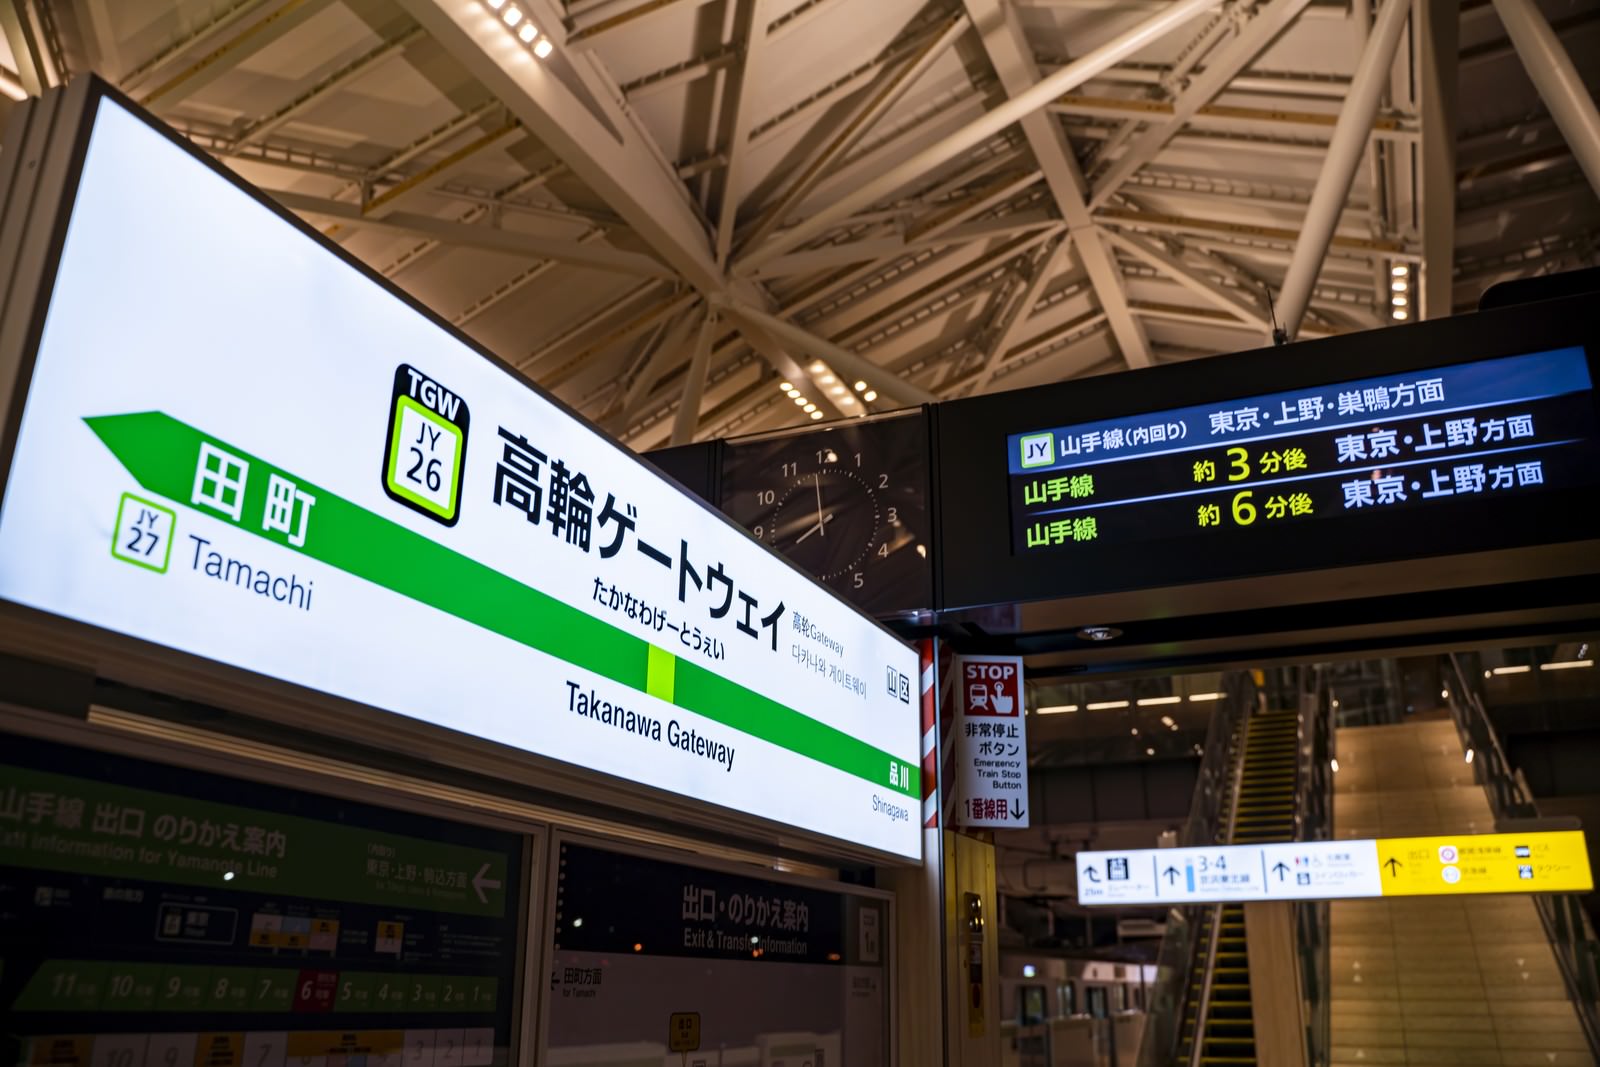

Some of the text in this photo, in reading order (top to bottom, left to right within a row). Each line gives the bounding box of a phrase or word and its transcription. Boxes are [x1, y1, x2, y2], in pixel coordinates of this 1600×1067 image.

[407, 368, 460, 421] TGW
[1209, 378, 1445, 435] 東京・上野・巣鴨方面
[416, 422, 441, 451] JY
[854, 453, 861, 467] 1
[1024, 414, 1534, 505] 山手線 約 3 分後 東京・上野方面
[1027, 442, 1048, 459] JY
[406, 447, 442, 492] 26
[782, 462, 797, 477] 11
[879, 474, 888, 488] 2
[191, 441, 316, 547] 田町
[757, 490, 775, 506] 10
[1026, 461, 1544, 548] 山手線 約 6 分後 東京・上野方面
[136, 509, 159, 530] JY
[887, 507, 897, 523] 3
[127, 528, 160, 557] 27
[493, 425, 786, 651] 高輪ゲートウェイ
[753, 526, 764, 540] 9
[877, 544, 888, 558] 4
[189, 534, 314, 611] Tamachi
[853, 573, 864, 588] 5
[792, 644, 826, 678] 다카나와
[966, 664, 1014, 680] STOP
[566, 680, 735, 772] Takanawa Gateway
[965, 723, 1019, 738] 非常停止
[979, 741, 1020, 756] ボタン
[974, 758, 1020, 769] Emergency
[977, 769, 1021, 779] Train Stop
[889, 760, 909, 791] 品川
[992, 780, 1022, 790] Button
[872, 794, 909, 821] Shinagawa
[965, 798, 1008, 820] 1番線用
[0, 786, 287, 858] 山手線 出口 のりかえ案内
[31, 833, 134, 861] Information
[139, 847, 162, 865] for
[167, 850, 242, 873] Yamanote
[248, 859, 278, 878] Line
[682, 884, 809, 933] 出口・のりかえ案内
[684, 927, 706, 948] Exit
[707, 931, 714, 948] &
[759, 937, 808, 956] Information
[52, 972, 77, 998] 11
[111, 974, 134, 998] 10
[564, 967, 602, 985] 田町方面
[165, 976, 181, 998] 9
[215, 978, 229, 1000] 8
[257, 979, 272, 1000] 7
[301, 980, 314, 1001] 6
[341, 982, 353, 1001] 5
[378, 983, 390, 1001] 4
[414, 984, 424, 1001] 3
[443, 984, 454, 1001] 2
[472, 985, 480, 1001] 1
